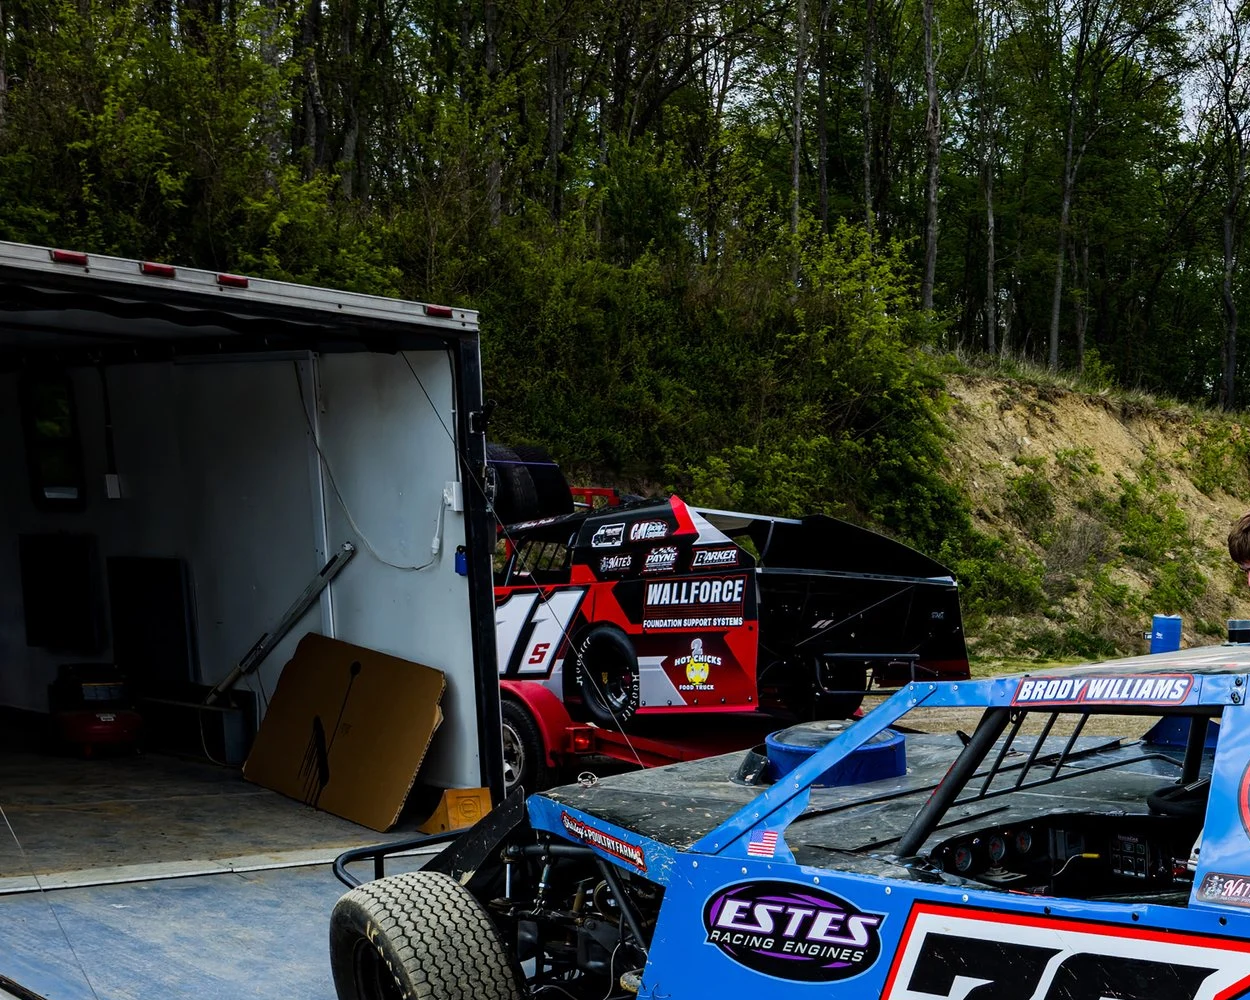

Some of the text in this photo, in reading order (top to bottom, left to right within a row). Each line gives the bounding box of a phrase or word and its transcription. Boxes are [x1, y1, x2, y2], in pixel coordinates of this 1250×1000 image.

[645, 553, 678, 564] PAYNE
[692, 549, 737, 567] BARKER
[646, 579, 744, 606] WALLFORCE
[643, 617, 743, 628] FOUNDATION SUPPORT SYSTEMS
[691, 638, 704, 657] 2
[674, 655, 722, 666] HOT CHICKS
[1017, 679, 1190, 700] BRODY WILLIAMS
[587, 829, 615, 851] POULTRY
[716, 899, 880, 947] ESTES
[710, 930, 865, 962] RACING ENGINES
